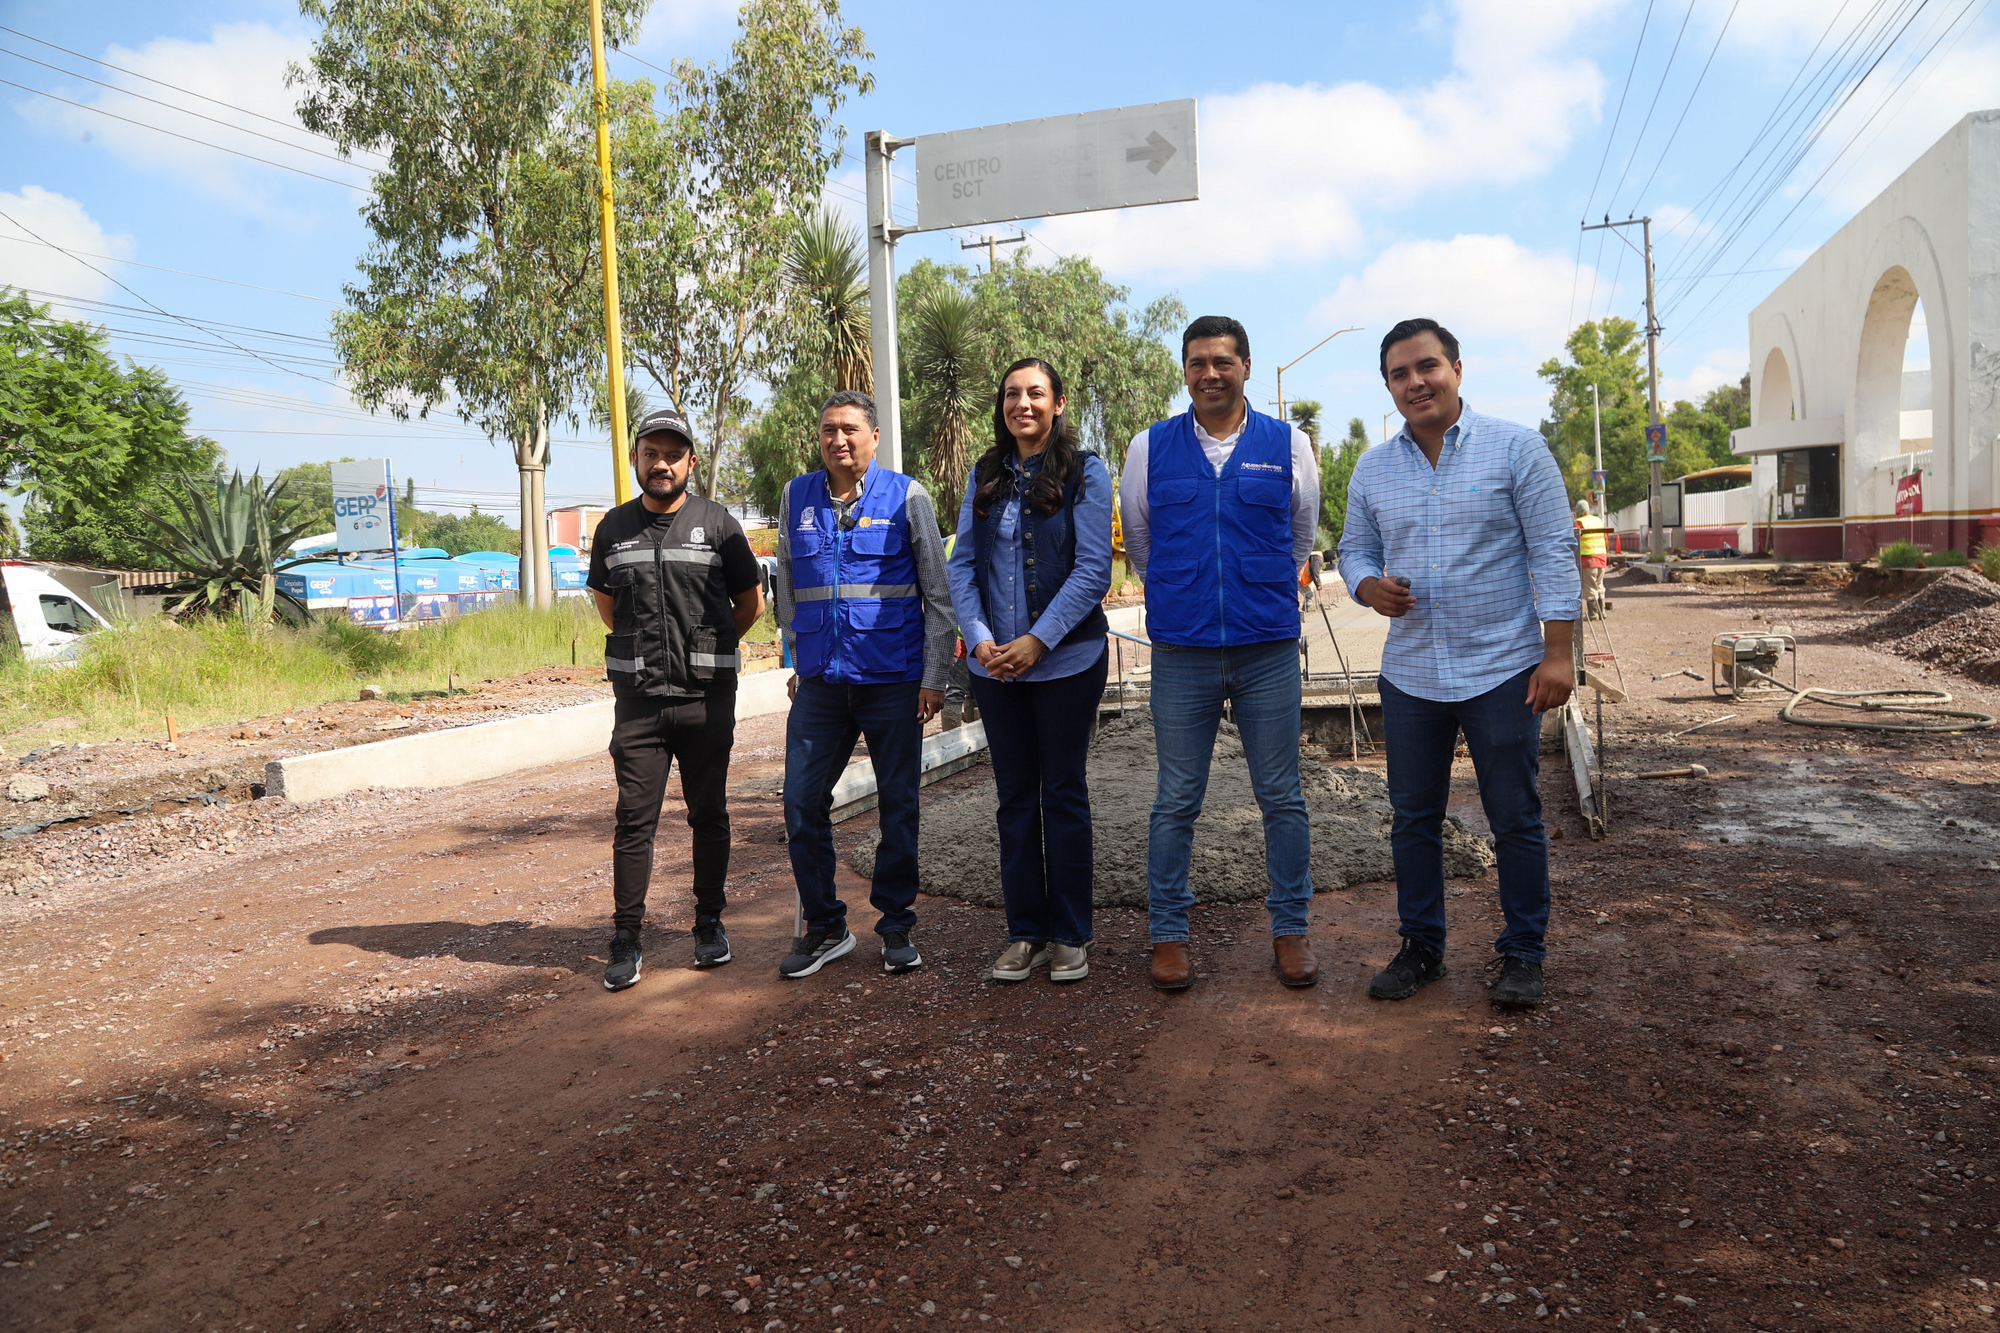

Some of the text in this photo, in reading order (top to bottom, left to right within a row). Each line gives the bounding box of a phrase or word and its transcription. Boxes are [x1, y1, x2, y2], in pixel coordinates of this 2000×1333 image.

[934, 156, 1001, 182] CENTRO
[952, 179, 984, 200] SCT
[334, 494, 377, 518] GEPP
